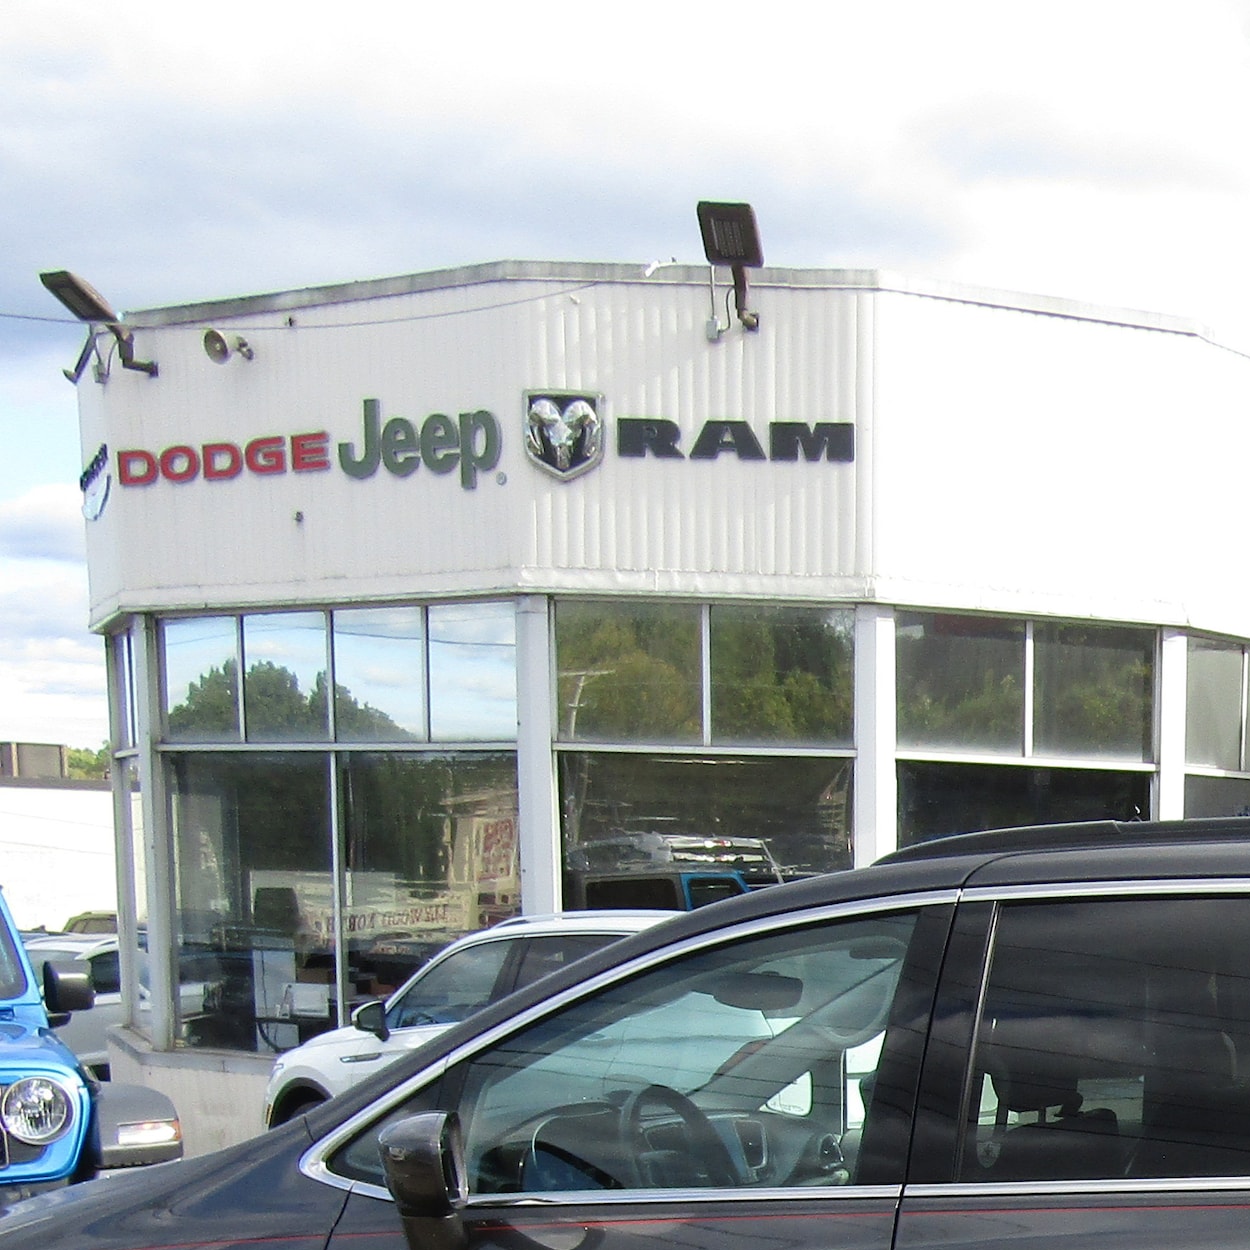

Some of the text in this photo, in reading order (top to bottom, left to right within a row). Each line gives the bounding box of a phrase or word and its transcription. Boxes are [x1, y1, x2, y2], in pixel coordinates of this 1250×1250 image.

[117, 431, 330, 486] DODGE
[338, 399, 502, 490] Jeep
[617, 418, 855, 463] RAM
